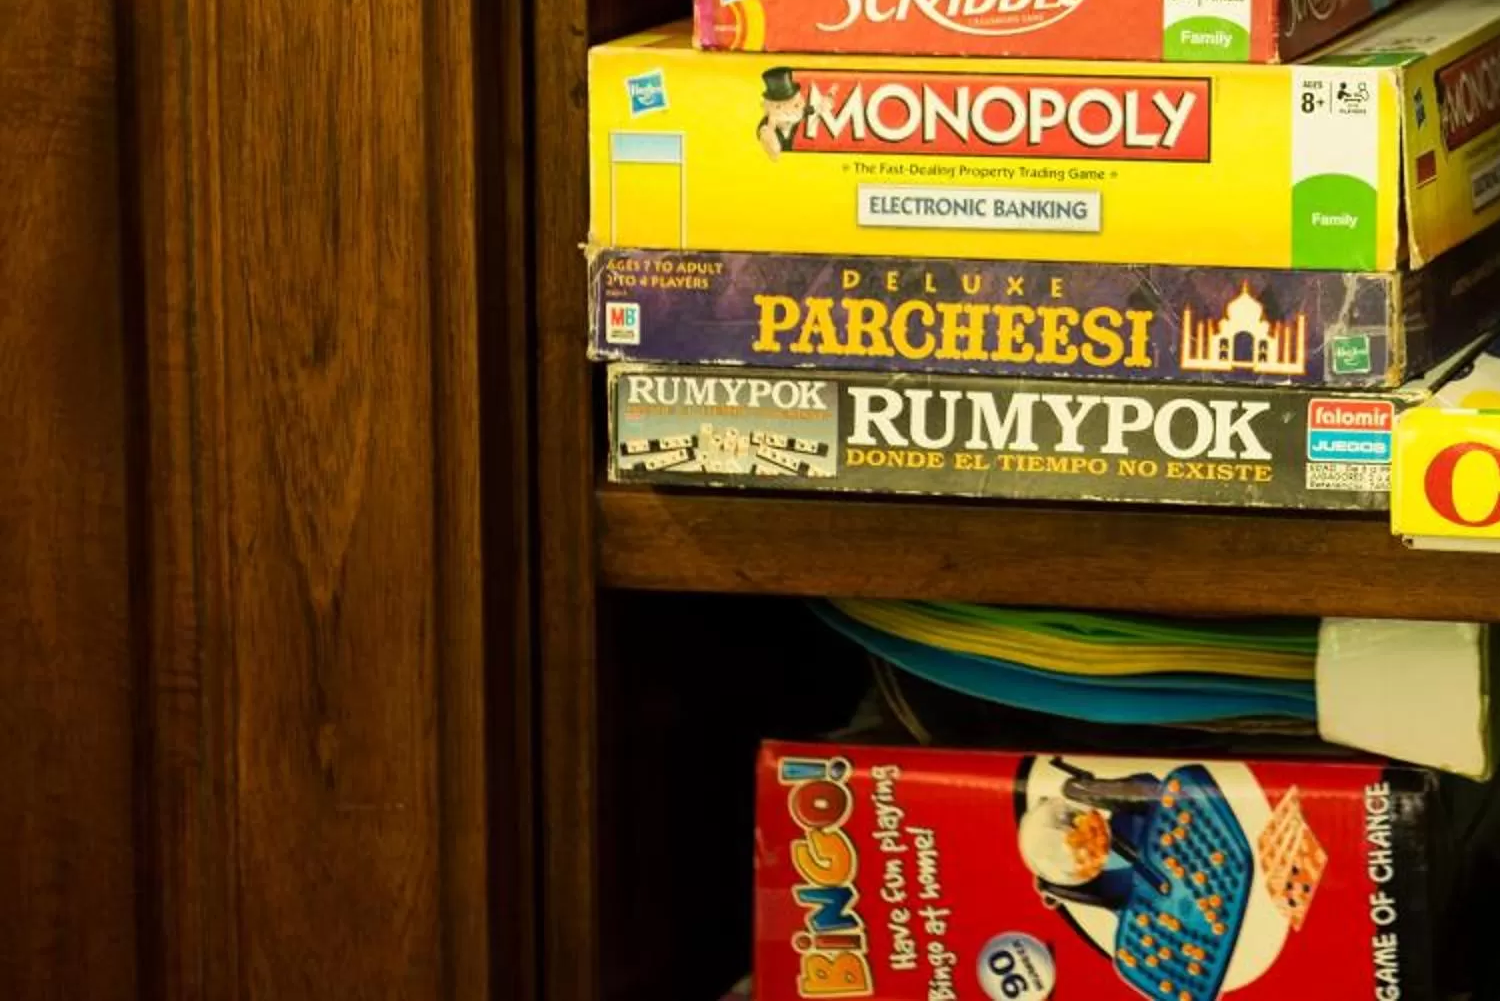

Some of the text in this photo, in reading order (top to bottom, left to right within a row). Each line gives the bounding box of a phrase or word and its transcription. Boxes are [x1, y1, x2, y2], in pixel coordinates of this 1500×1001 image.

[1181, 30, 1234, 48] Family
[804, 82, 1197, 149] MONOPOLY
[1301, 92, 1324, 114] 8+
[853, 162, 1105, 181] The Fast-Dealing Property Trading Game
[869, 195, 1088, 220] ELECTRONIC BANKING
[1311, 212, 1359, 229] Family
[654, 261, 673, 273] TO
[676, 262, 723, 274] ADULT
[618, 275, 636, 287] TO
[651, 275, 709, 289] PLAYERS
[842, 270, 1062, 298] DELUXE
[611, 307, 636, 327] MB
[752, 294, 1153, 368] PARCHEESI
[627, 375, 828, 410] RUMYPOK
[847, 386, 1272, 460] RUMYPOK
[1315, 406, 1388, 426] falomir
[1312, 439, 1386, 454] JUEGOS
[846, 448, 1274, 482] DONDE EL TIEMPO NO EXISTE
[871, 764, 918, 970] Have fun playing
[905, 827, 939, 899] home!
[1364, 781, 1402, 1001] GAME OF CHANCE
[918, 906, 951, 936] at
